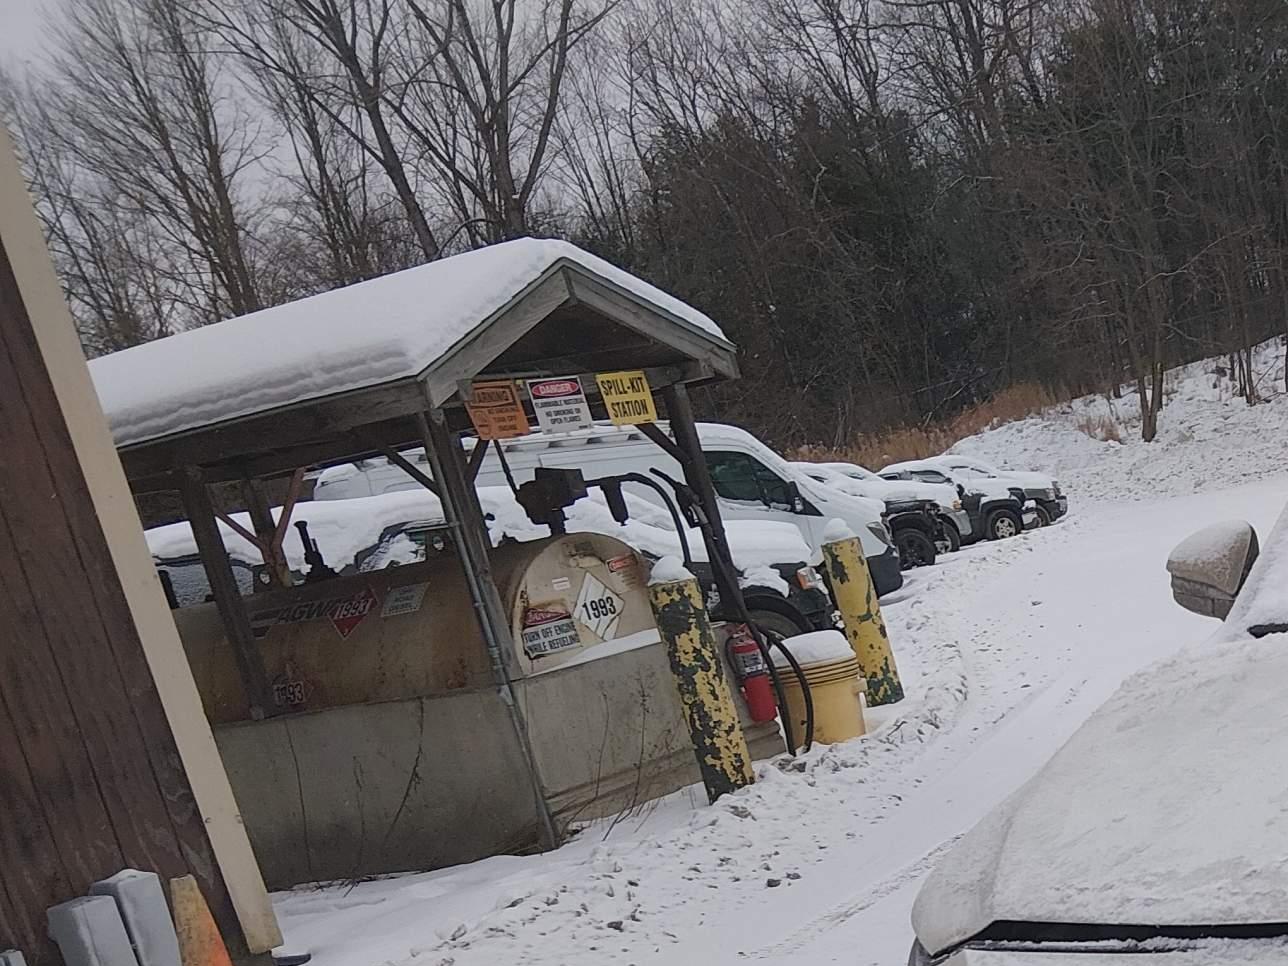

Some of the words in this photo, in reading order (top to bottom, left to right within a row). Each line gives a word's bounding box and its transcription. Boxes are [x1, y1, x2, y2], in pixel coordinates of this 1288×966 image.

[600, 376, 646, 397] SPILL-KIT
[611, 398, 649, 419] STATION
[336, 599, 369, 618] 1993
[581, 596, 618, 622] 1993
[541, 624, 554, 639] OFF
